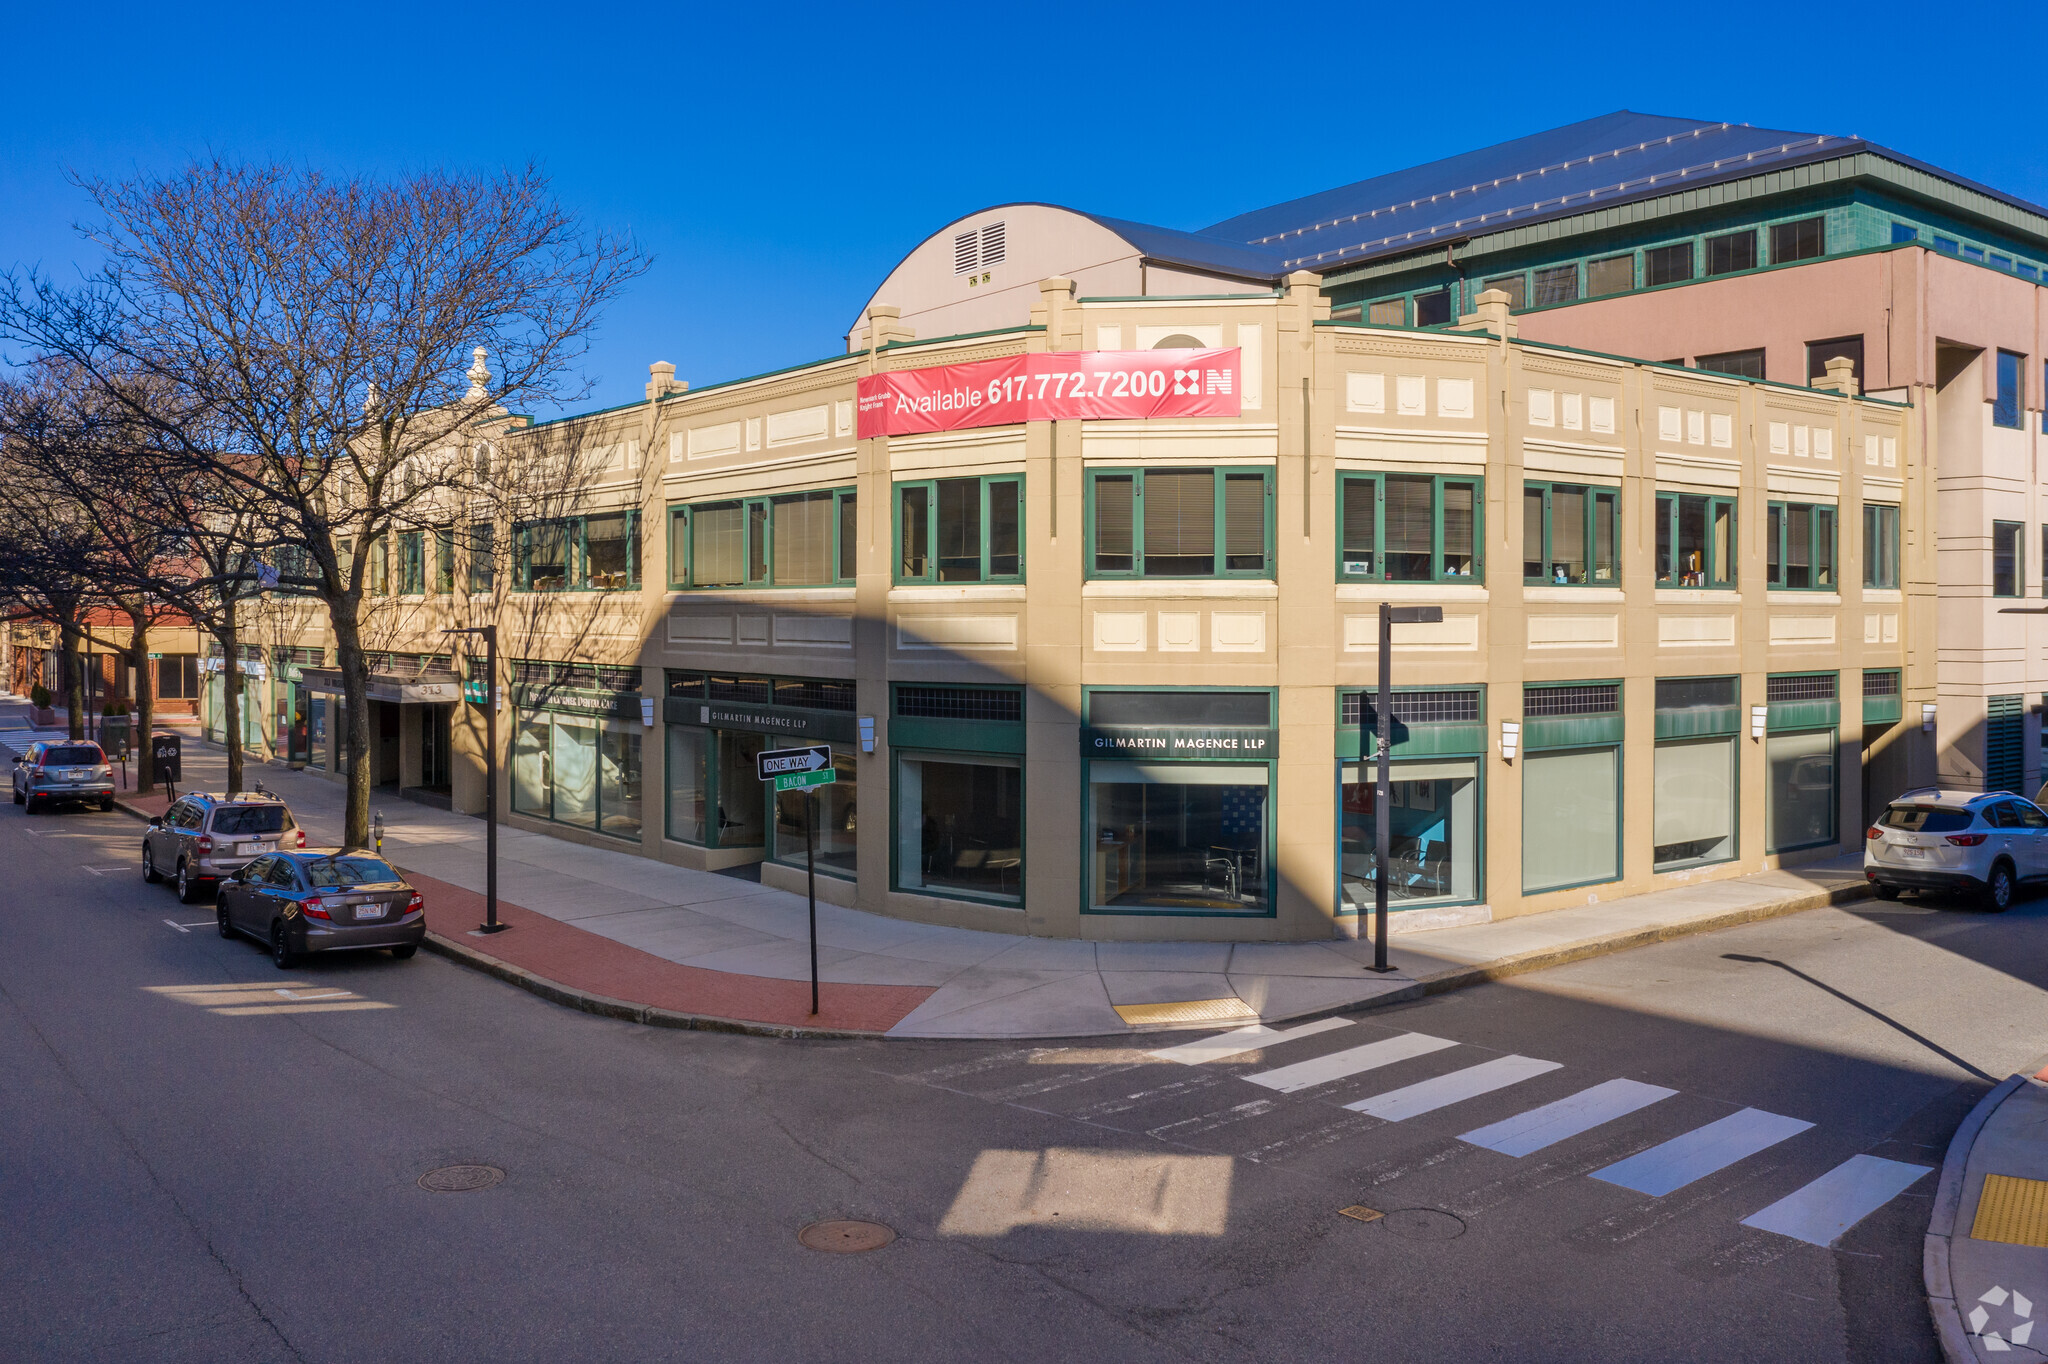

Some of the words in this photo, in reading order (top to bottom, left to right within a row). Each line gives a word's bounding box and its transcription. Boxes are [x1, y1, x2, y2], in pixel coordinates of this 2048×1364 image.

[894, 386, 982, 415] Available
[987, 370, 1166, 405] 617.772.7200
[860, 402, 873, 412] Knight
[872, 400, 884, 409] Frank
[420, 685, 443, 696] 313
[600, 698, 618, 710] CARE
[712, 711, 752, 723] GILMARTIN
[754, 716, 791, 727] MAGENCE
[793, 719, 807, 728] LLP
[1094, 738, 1166, 748] GILMARTIN
[1174, 738, 1238, 749] MAGENCE
[1244, 738, 1266, 749] LLP
[766, 758, 787, 771] ONE
[788, 756, 809, 768] WAY
[783, 775, 807, 788] BACON
